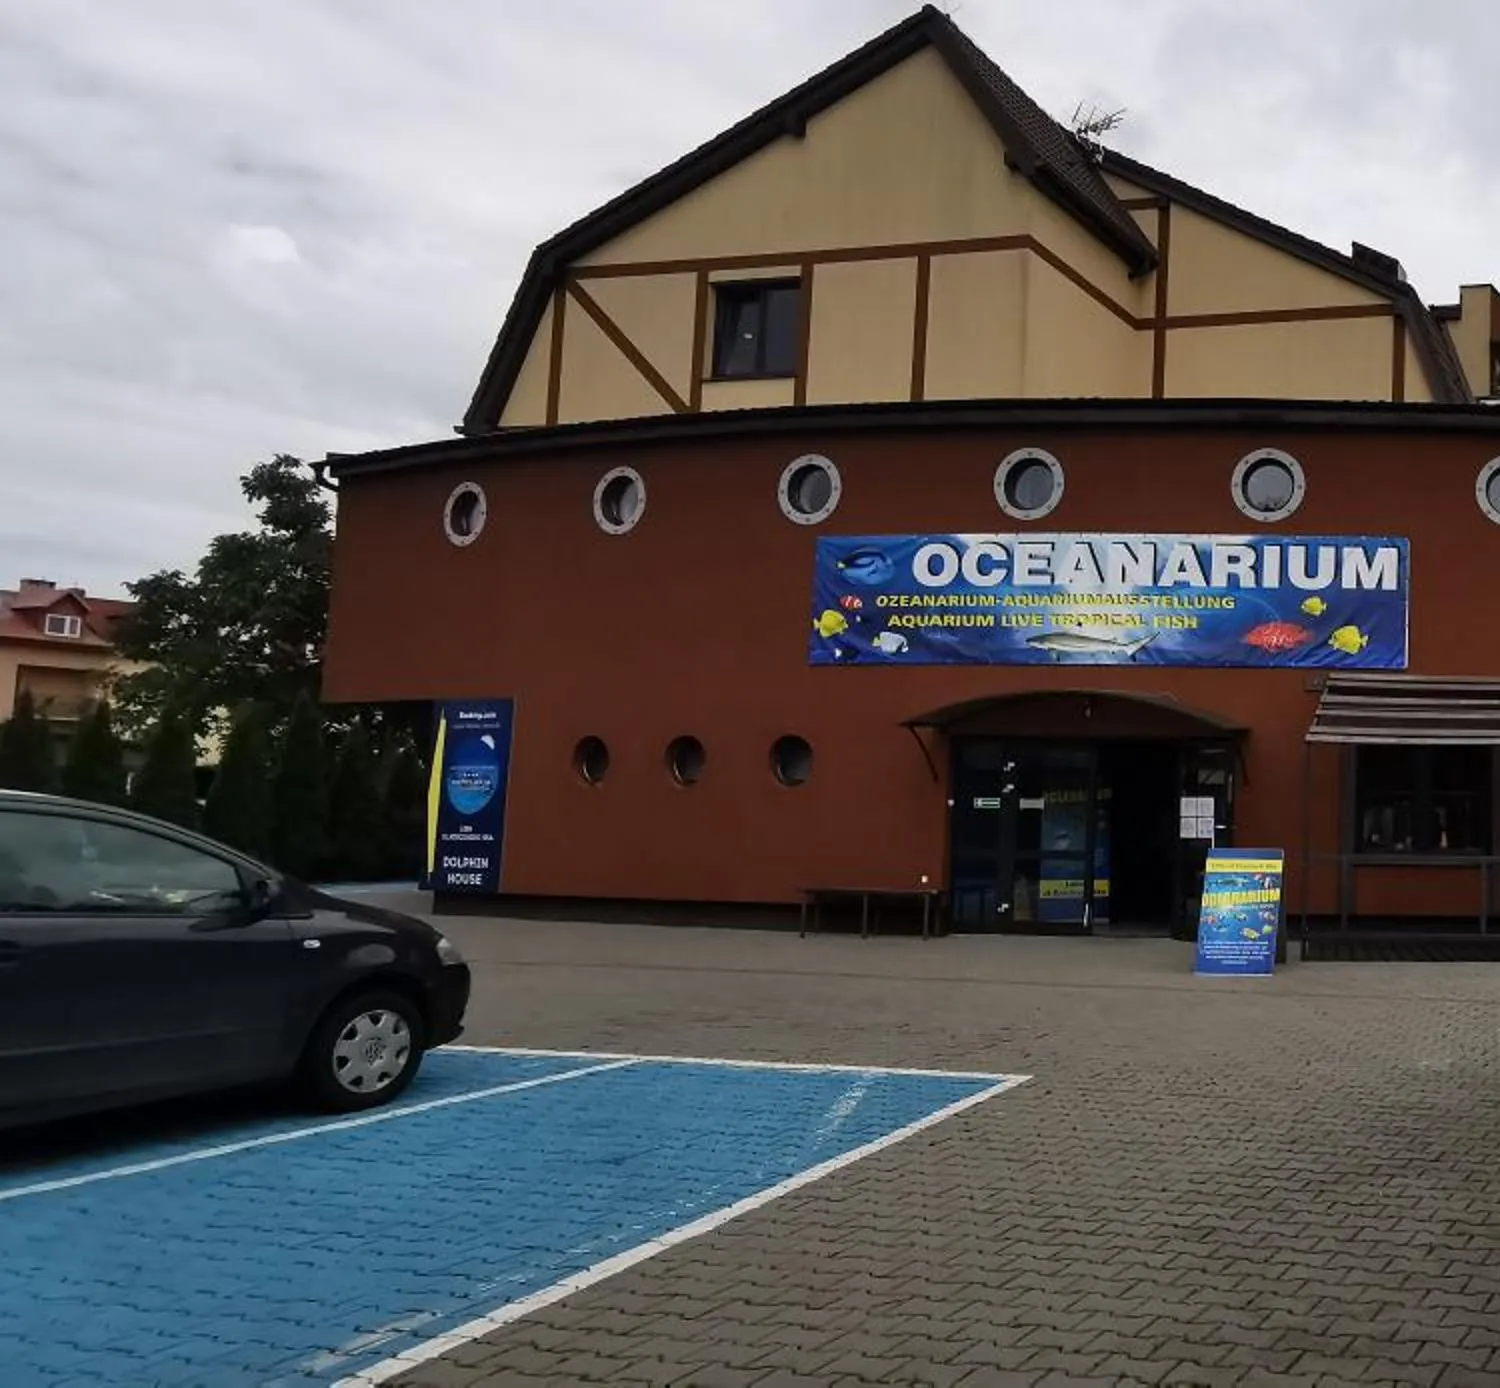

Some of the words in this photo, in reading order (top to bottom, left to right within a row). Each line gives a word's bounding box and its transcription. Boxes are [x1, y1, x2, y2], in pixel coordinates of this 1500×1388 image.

[911, 541, 1400, 591] OCEANARIUM
[875, 592, 1236, 610] OZEANARIUM-AQUARIUMAUSSTELLUNG
[887, 613, 995, 628] AQUARIUM
[1001, 612, 1045, 628] LIVE
[1049, 613, 1147, 628] TROPICAL
[1153, 615, 1199, 630] FISH
[443, 855, 489, 869] DOLPHIN
[447, 873, 482, 885] HOUSE
